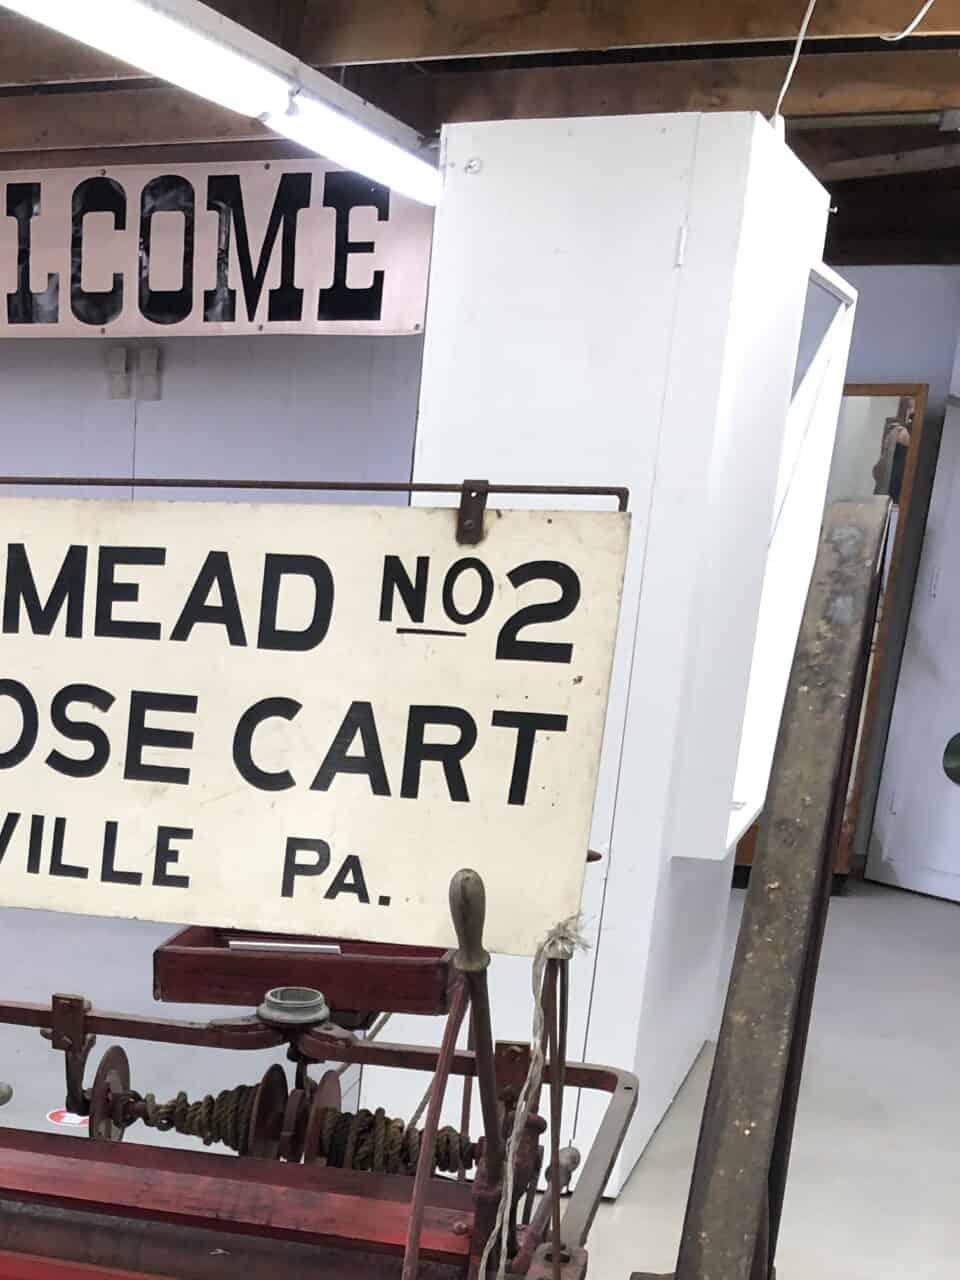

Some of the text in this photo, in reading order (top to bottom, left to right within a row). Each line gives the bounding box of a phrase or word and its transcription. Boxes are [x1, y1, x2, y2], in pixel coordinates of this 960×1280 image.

[3, 543, 335, 652] MEAD
[232, 696, 569, 806] CART
[280, 836, 391, 906] PA.
